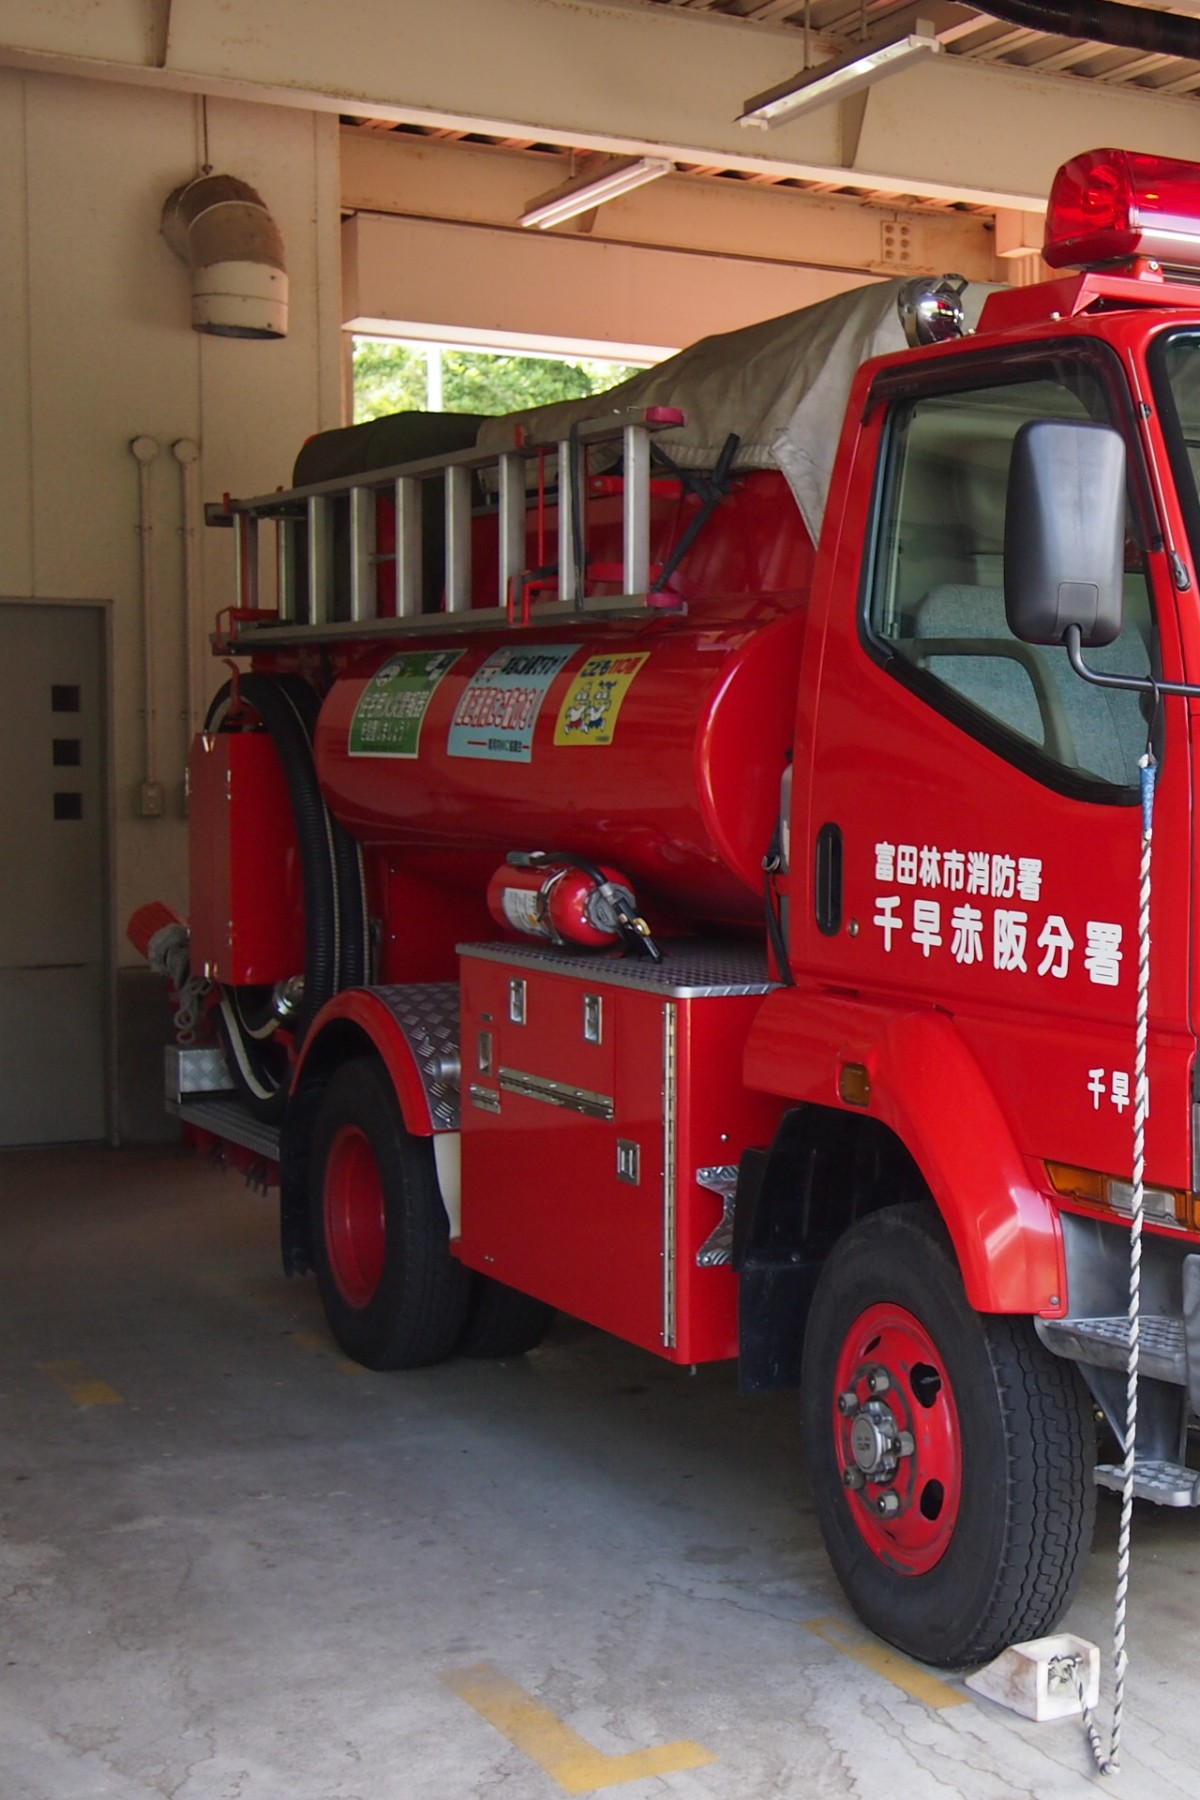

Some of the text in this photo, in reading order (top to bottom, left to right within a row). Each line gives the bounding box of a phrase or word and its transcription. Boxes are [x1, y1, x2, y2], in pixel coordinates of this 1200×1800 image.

[875, 841, 1042, 902] 富田林市消防署
[873, 896, 1123, 986] 千早赤阪分署
